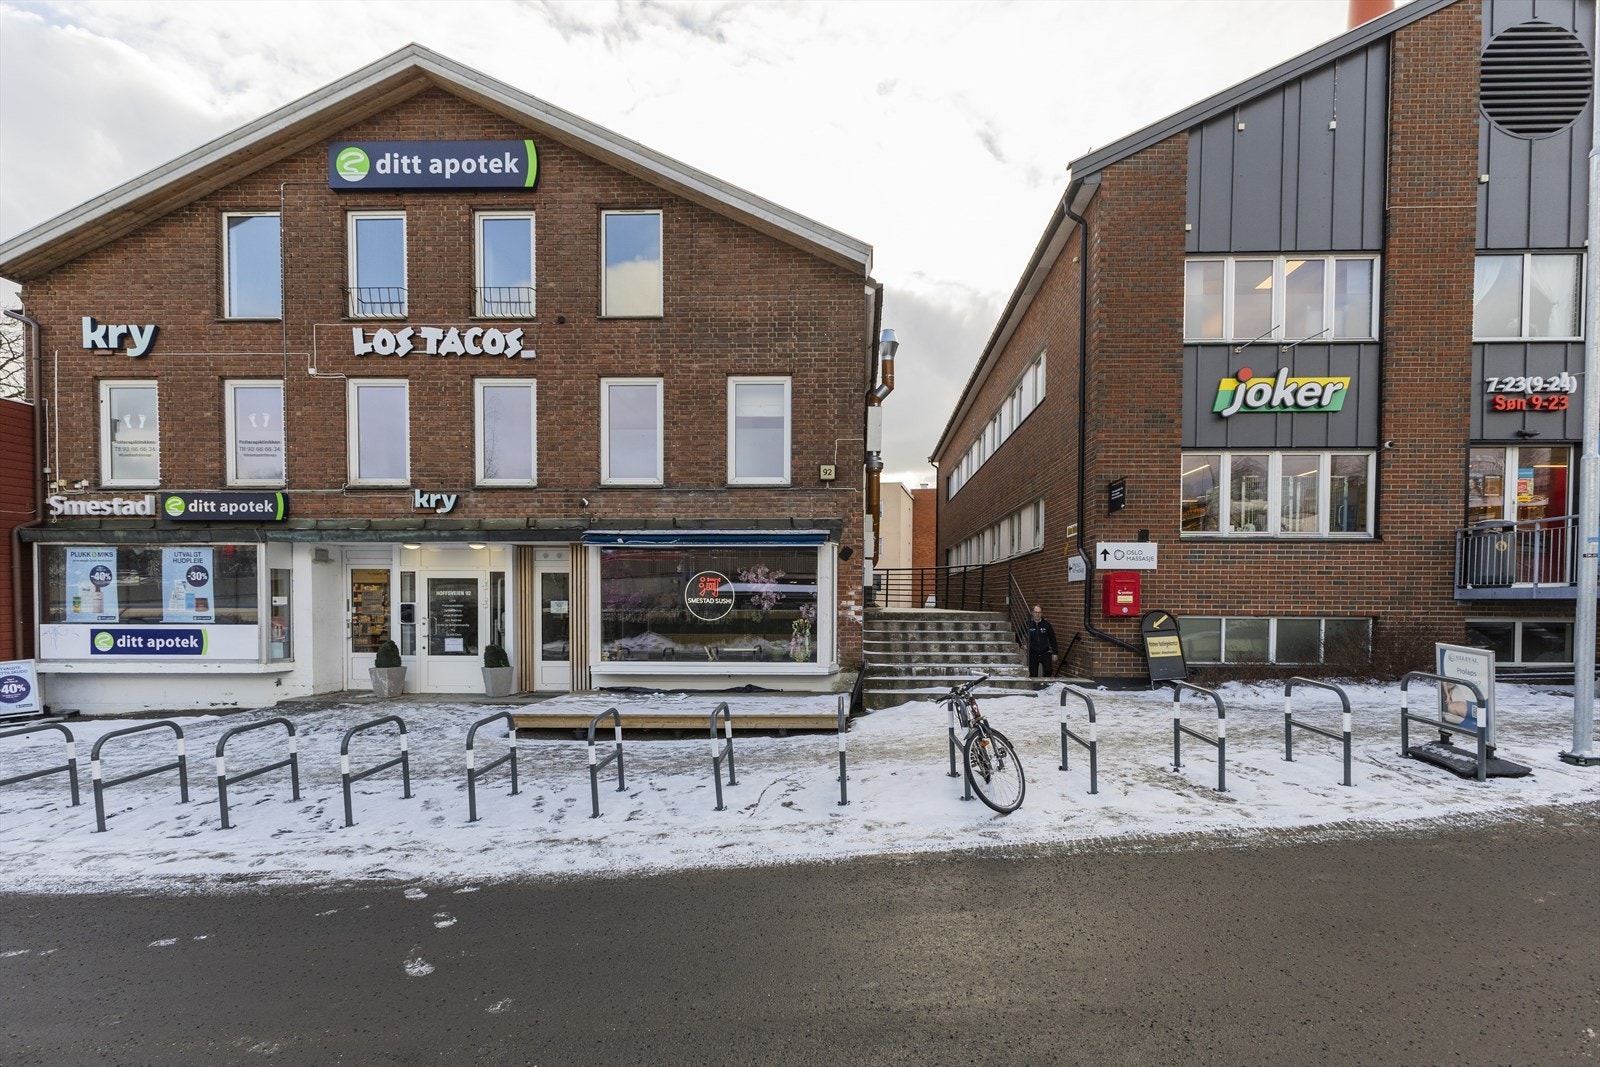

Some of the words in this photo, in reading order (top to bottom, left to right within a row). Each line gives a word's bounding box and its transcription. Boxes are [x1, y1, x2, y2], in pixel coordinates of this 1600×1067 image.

[375, 152, 422, 174] ditt
[428, 152, 519, 179] apotek
[82, 316, 155, 357] kry
[352, 326, 415, 358] LOS
[1221, 366, 1345, 417] joker
[1494, 394, 1526, 411] Søn
[1531, 394, 1569, 411] 9-23
[822, 468, 833, 476] 92
[49, 495, 156, 516] Smestad
[188, 500, 217, 513] ditt
[220, 500, 274, 516] apotek
[414, 489, 457, 513] kry
[91, 571, 112, 581] -40%
[187, 571, 208, 581] -30%
[715, 597, 733, 605] SUSHI
[116, 635, 145, 648] ditt
[147, 635, 199, 651] apotek
